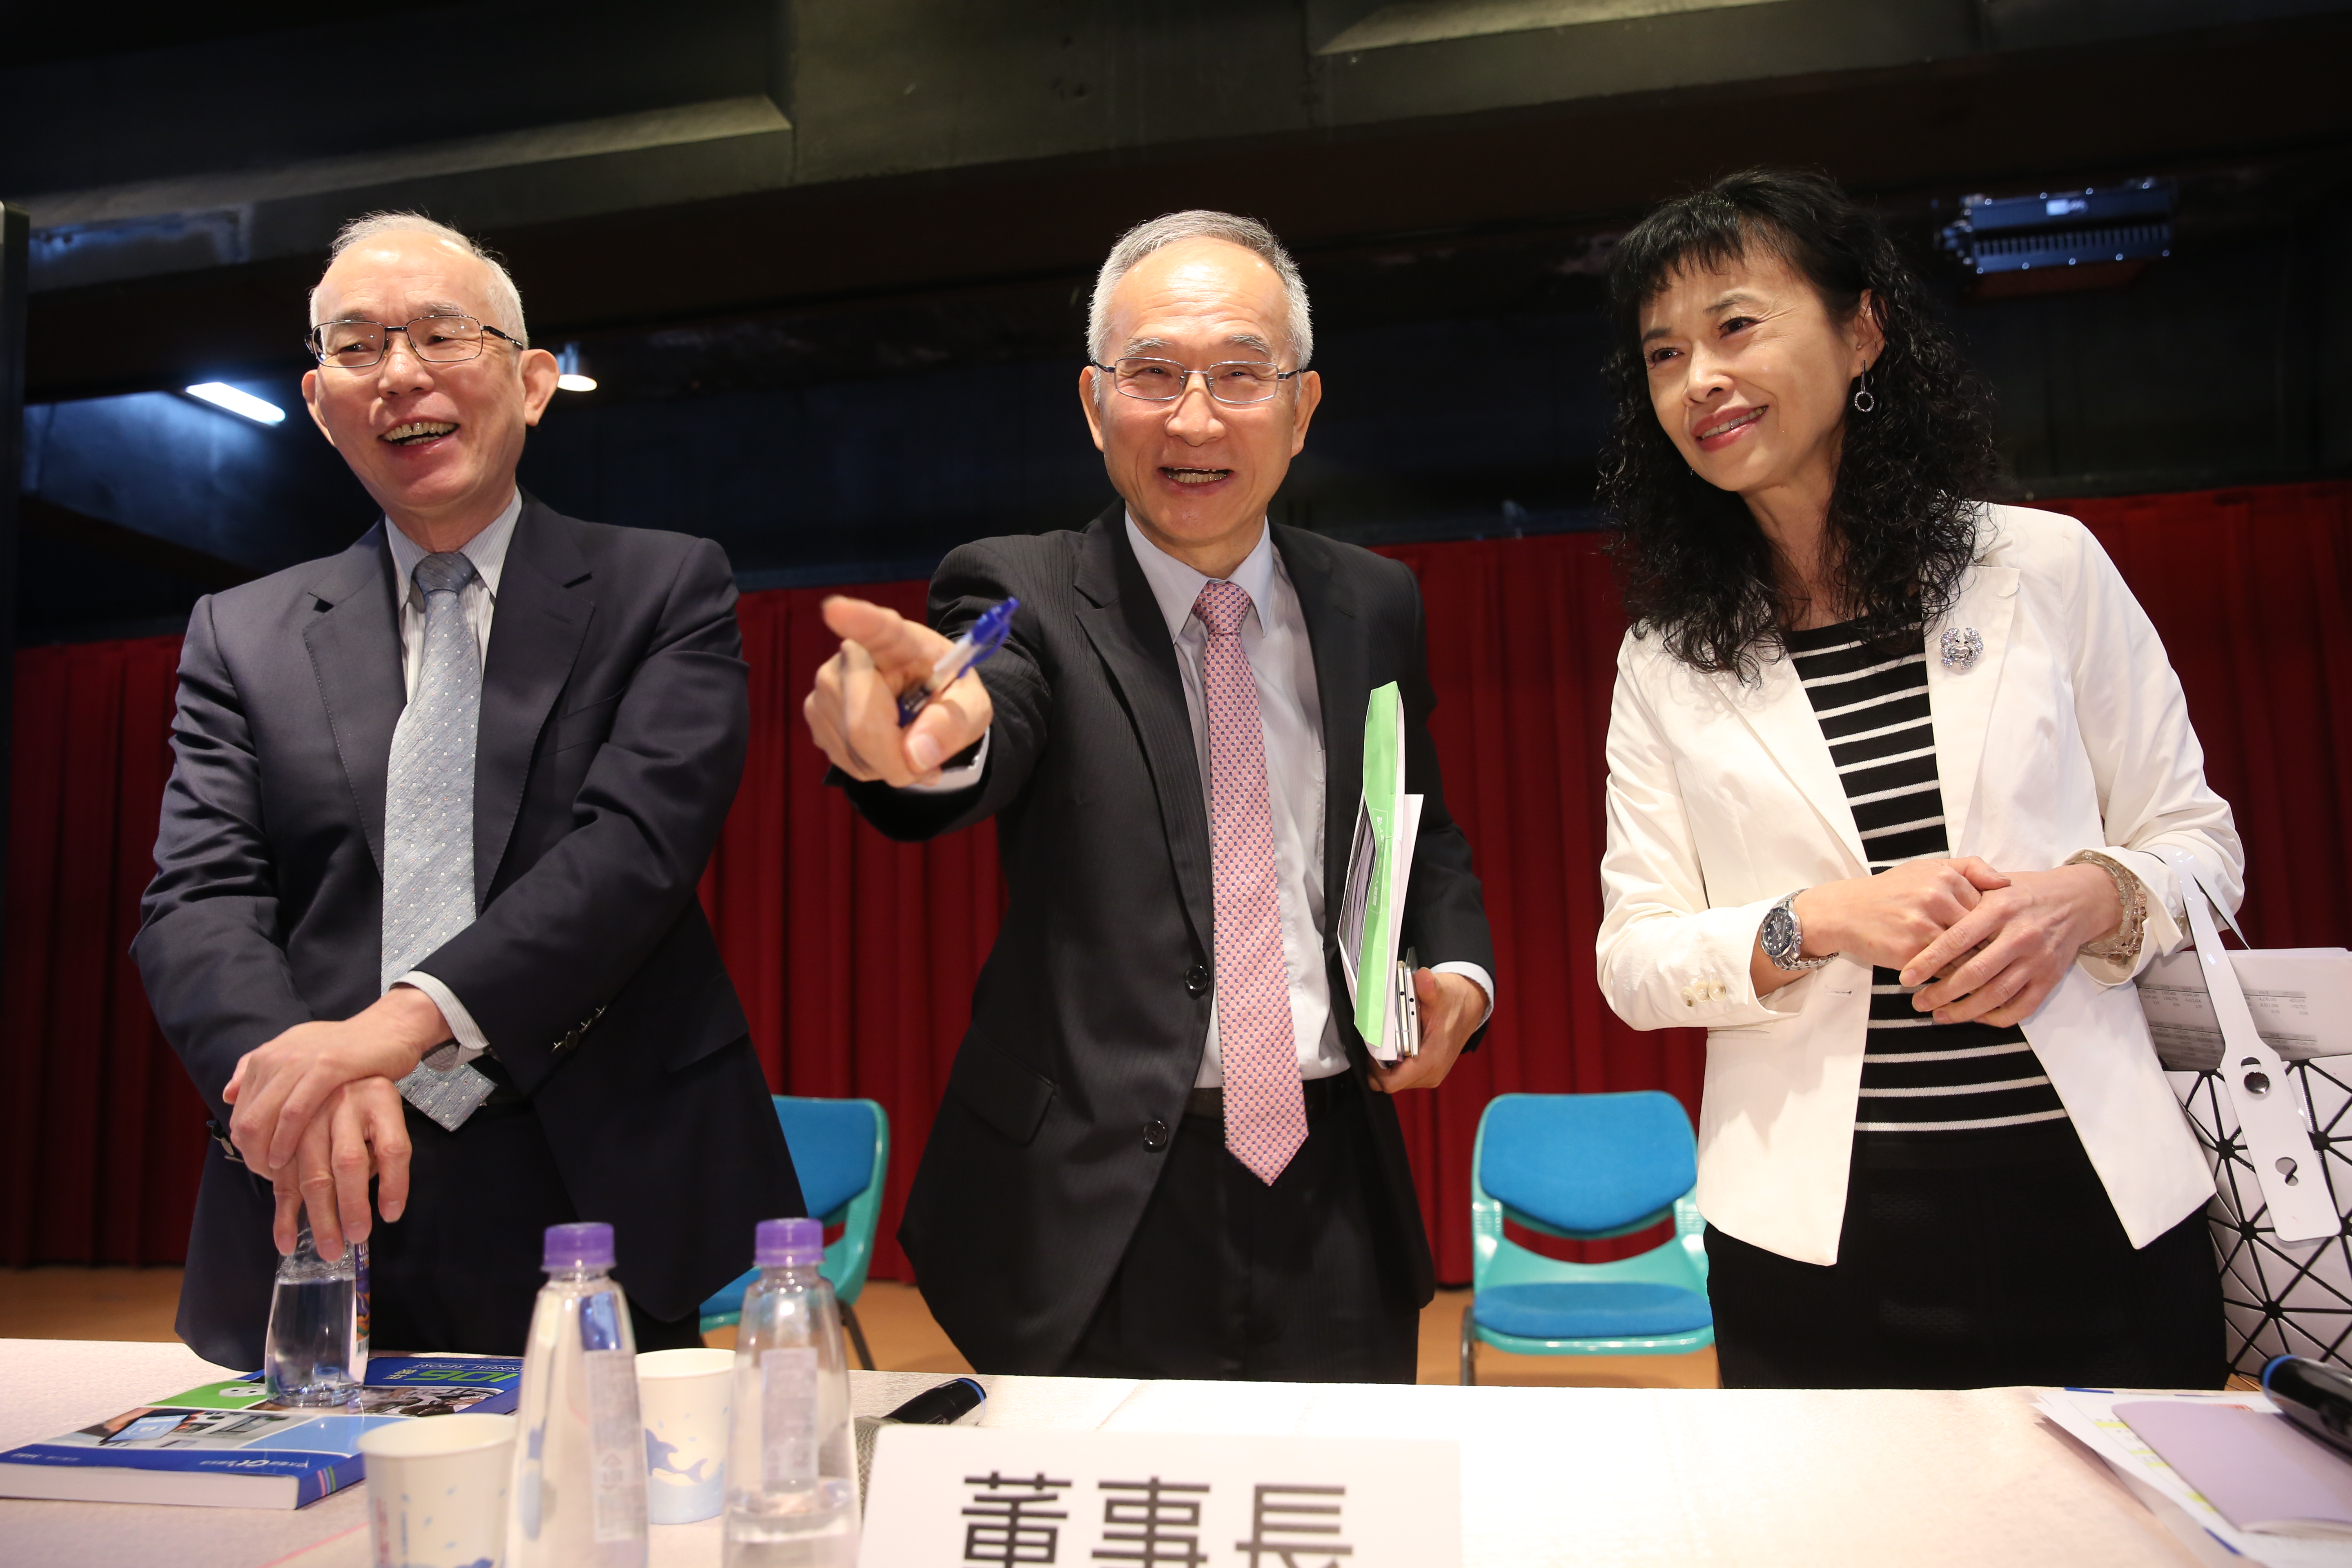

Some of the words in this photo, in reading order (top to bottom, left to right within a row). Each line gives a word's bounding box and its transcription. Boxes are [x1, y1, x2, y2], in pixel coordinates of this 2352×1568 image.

[403, 1370, 519, 1383] 106
[961, 1470, 1354, 1568] 董事長
